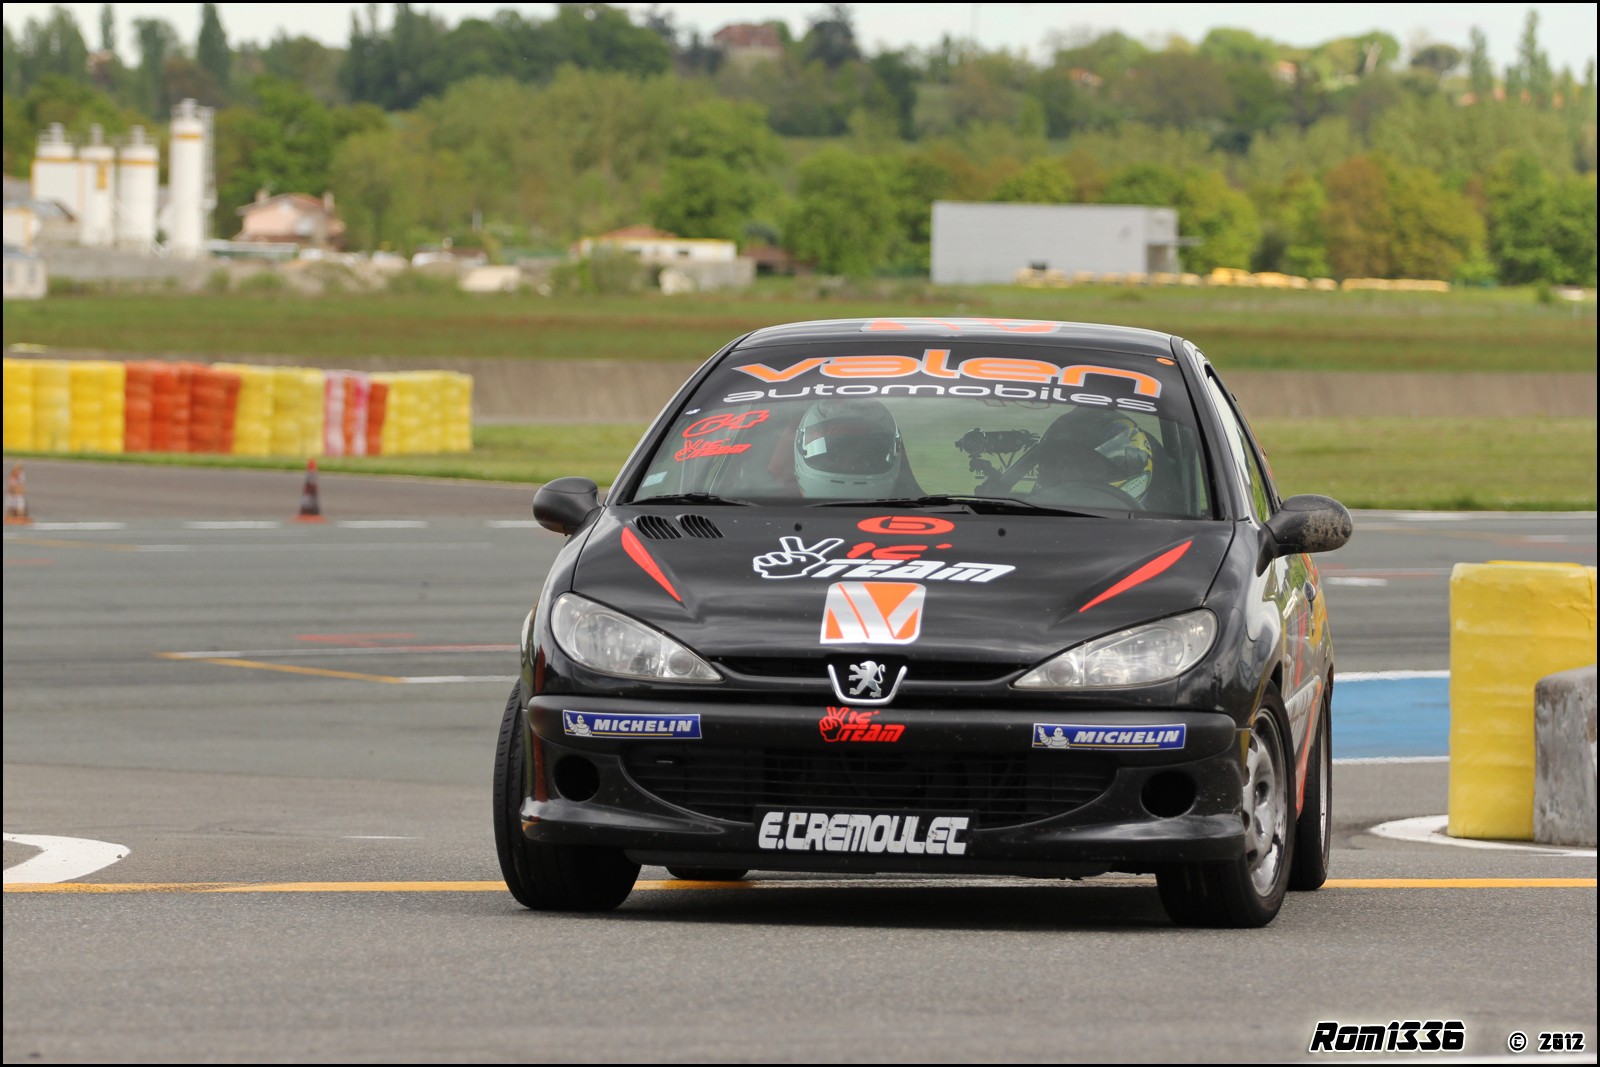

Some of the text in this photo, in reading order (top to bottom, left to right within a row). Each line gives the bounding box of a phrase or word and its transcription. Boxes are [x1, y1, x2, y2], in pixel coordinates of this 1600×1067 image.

[731, 349, 1162, 398] valen
[724, 384, 1157, 412] automobiles
[811, 559, 1016, 583] TEAM
[593, 719, 693, 732] MICHELIN
[840, 724, 905, 742] TEAM
[1073, 731, 1180, 743] MICHELIN
